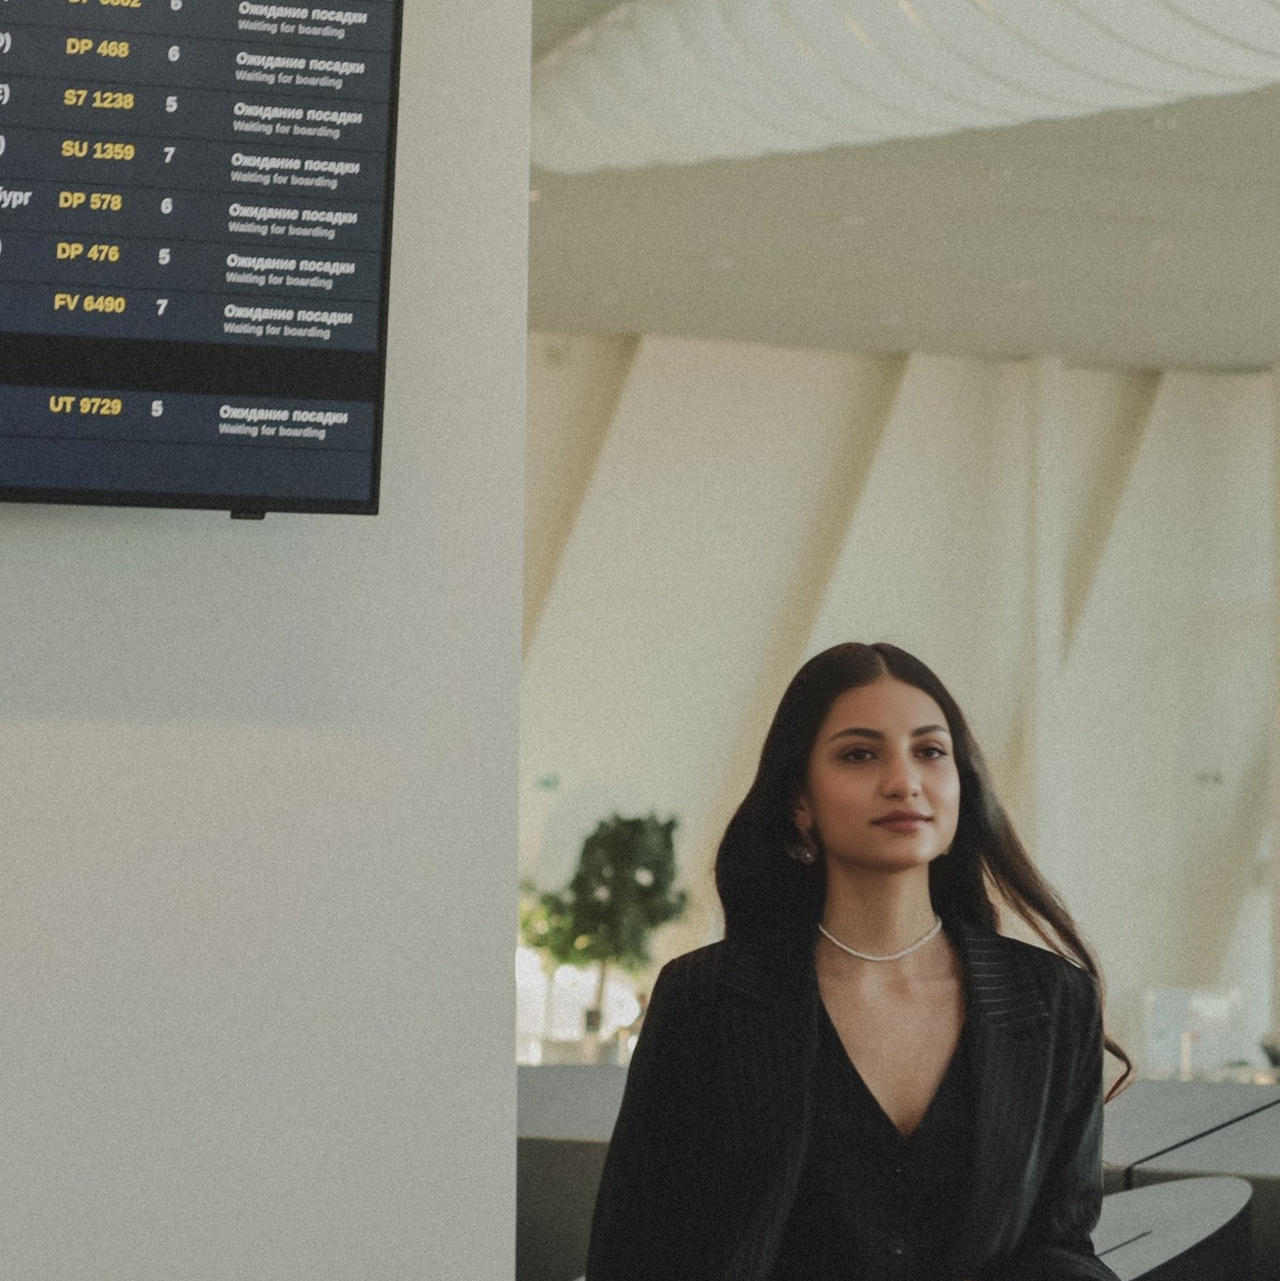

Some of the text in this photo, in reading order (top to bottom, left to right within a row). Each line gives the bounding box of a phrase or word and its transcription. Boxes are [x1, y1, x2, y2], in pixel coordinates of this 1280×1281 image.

[239, 1, 368, 25] Ожидание посадки
[238, 20, 345, 40] Waiting for boarding
[66, 38, 129, 58] DP 468
[168, 45, 180, 62] 6
[236, 52, 365, 75] Ожидание посадки
[235, 70, 342, 89] Waiting for boarding
[64, 89, 134, 109] S7 1238
[166, 96, 178, 113] 5
[234, 102, 363, 125] Ожидание посадки
[233, 120, 340, 139] Waiting for boarding
[61, 140, 135, 160] SU 1359
[164, 147, 175, 163] 7
[231, 153, 360, 175] Ожидание посадки
[231, 171, 338, 189] Waiting for boarding
[59, 191, 122, 211] DP 578
[161, 198, 173, 214] 6
[229, 203, 358, 226] Ожидание посадки
[228, 221, 335, 239] Waiting for boarding
[57, 242, 120, 262] DP 476
[158, 248, 171, 265] 5
[226, 254, 355, 276] Ожидание посадки
[226, 272, 333, 290] Waiting for boarding
[54, 293, 126, 313] FV 6490
[156, 299, 168, 316] 7
[224, 304, 353, 326] Ожидание посадки
[223, 322, 330, 339] Waiting for boarding
[49, 396, 122, 415] UT 9729
[151, 400, 163, 417] 5
[219, 405, 348, 426] Ожидание посадки
[219, 423, 326, 440] Waiting for boarding
